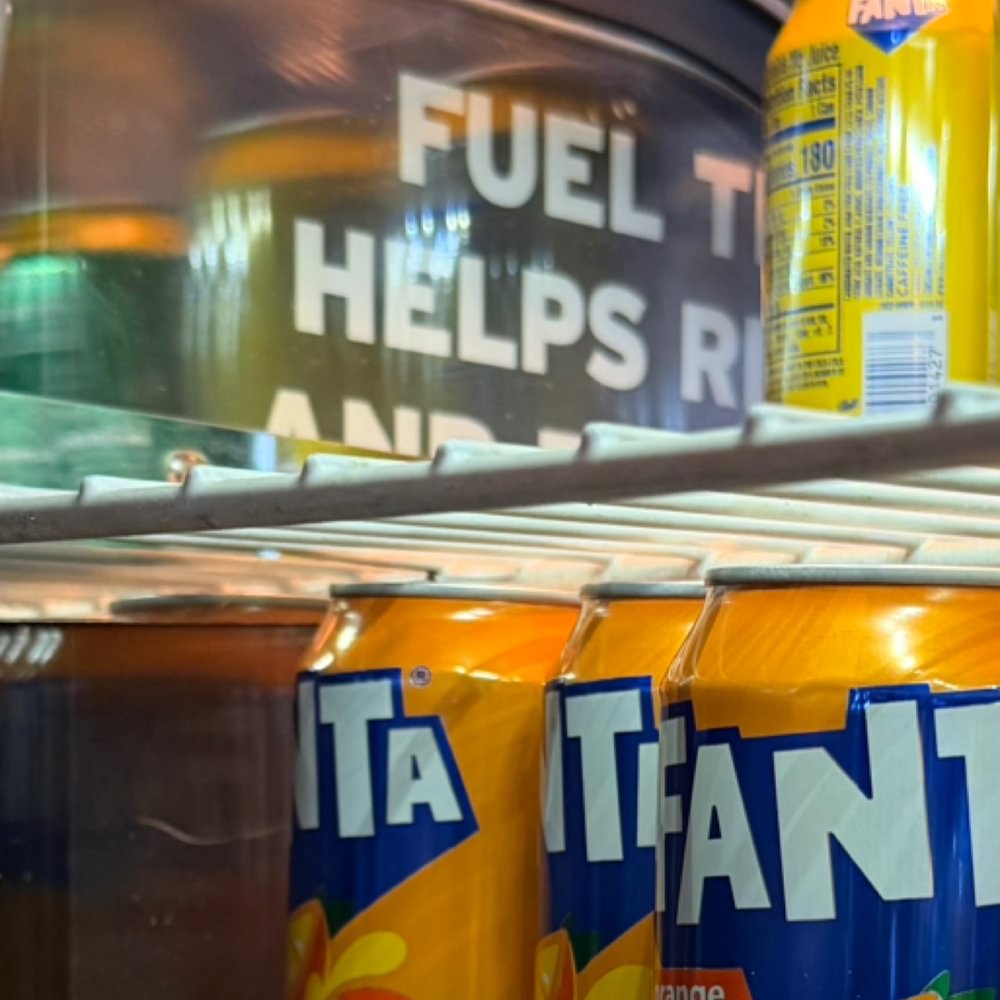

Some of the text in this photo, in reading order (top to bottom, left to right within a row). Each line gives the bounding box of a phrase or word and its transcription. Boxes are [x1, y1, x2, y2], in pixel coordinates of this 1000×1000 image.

[399, 72, 665, 243] FUEL
[694, 153, 765, 266] T
[801, 140, 835, 174] 180
[292, 217, 649, 392] HELPS
